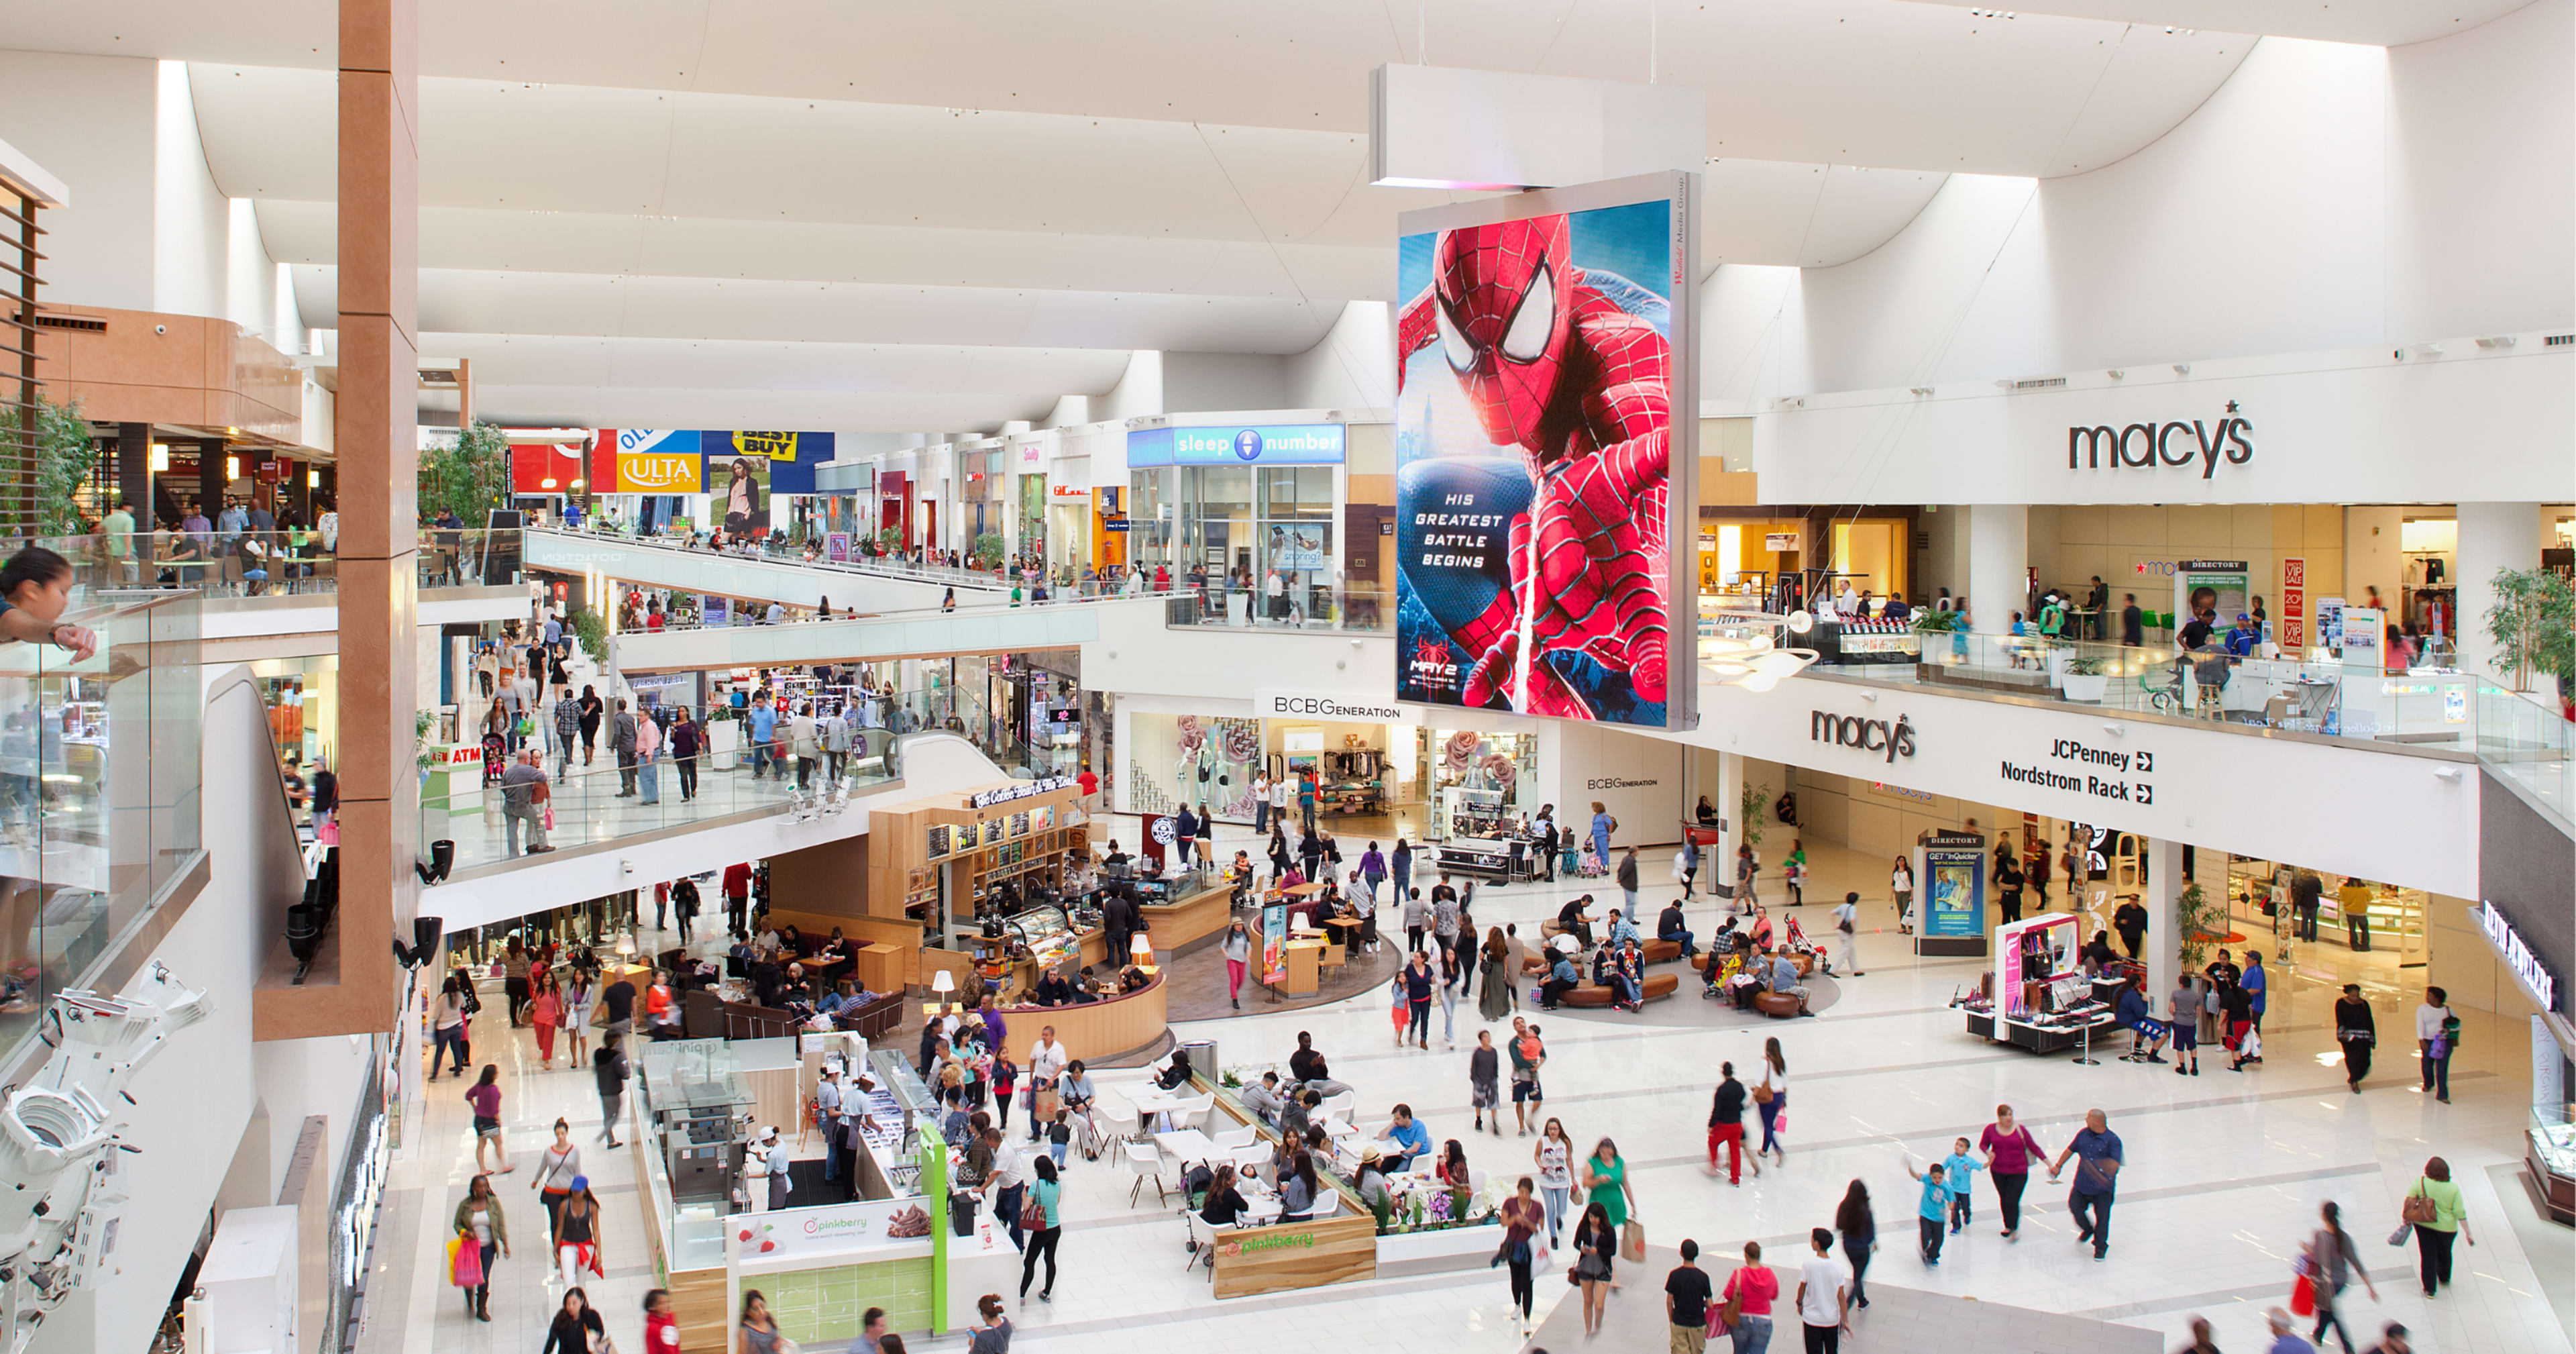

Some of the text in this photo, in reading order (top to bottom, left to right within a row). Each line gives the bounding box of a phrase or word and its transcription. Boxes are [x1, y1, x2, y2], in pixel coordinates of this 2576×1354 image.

[1677, 178, 1685, 209] Group
[744, 439, 791, 454] BUY
[1179, 433, 1339, 456] sleep number
[633, 459, 692, 478] ULTA
[1445, 494, 1474, 505] HIS
[1415, 513, 1503, 527] GREATEST
[1424, 534, 1487, 547] BATTLE
[1422, 554, 1485, 568] BEGINS
[2286, 567, 2302, 576] VIP
[2286, 576, 2302, 584] SALE
[2286, 627, 2301, 637] VIP
[2285, 635, 2301, 644] SALE
[1409, 660, 1457, 675] MAY 2
[633, 675, 686, 689] FASHION FIRST
[453, 747, 481, 764] ATM
[2051, 739, 2129, 772] JCPenney
[990, 787, 1014, 804] Coffee
[1014, 784, 1036, 798] Bean
[1036, 781, 1042, 793] &
[1042, 778, 1056, 791] Tea
[1057, 772, 1077, 788] Leaf
[2001, 761, 2130, 801] Nordstrom Rack
[818, 1218, 867, 1232] pinkberry
[1242, 1233, 1313, 1255] pinkberry
